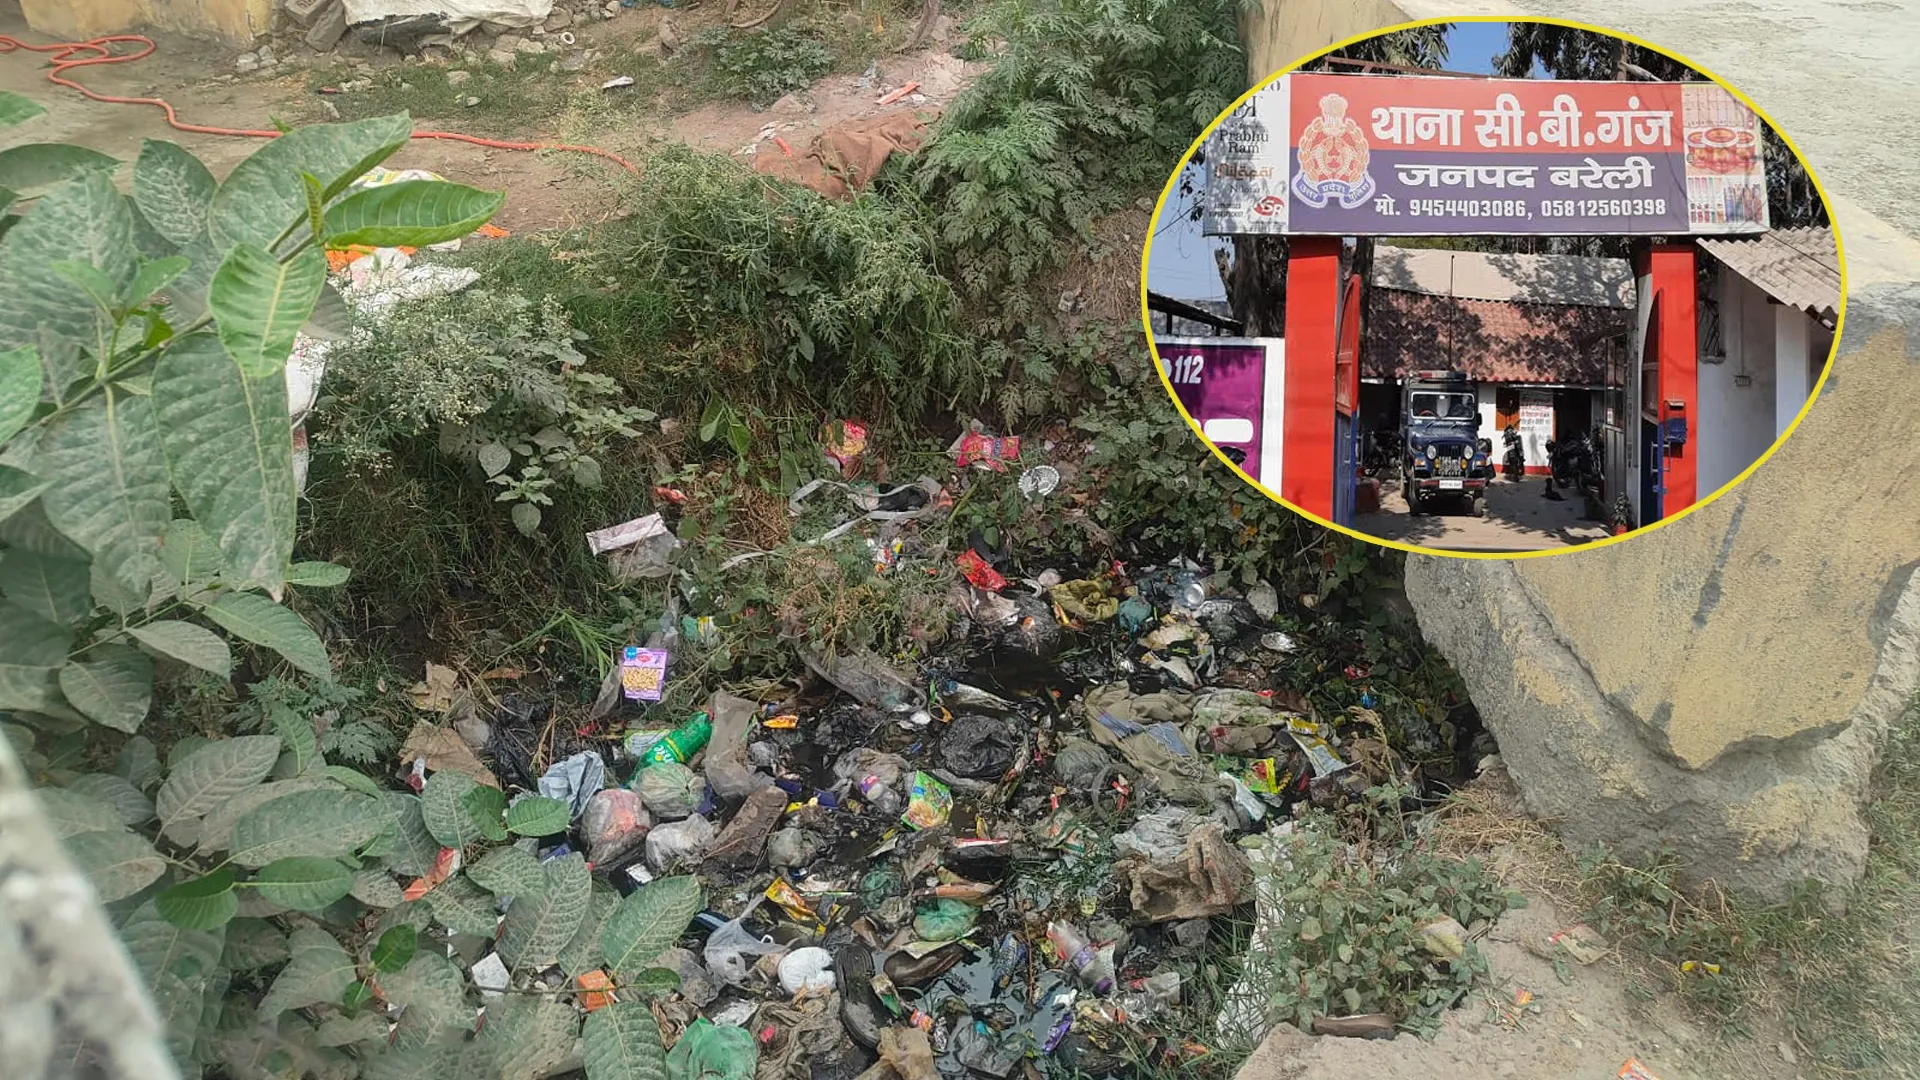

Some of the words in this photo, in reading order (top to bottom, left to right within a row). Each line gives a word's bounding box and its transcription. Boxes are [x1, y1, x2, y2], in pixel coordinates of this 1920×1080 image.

[1371, 106, 1464, 146] थाना
[1473, 93, 1674, 148] सी.बी.गंज
[1219, 130, 1268, 142] Prabhu
[1228, 142, 1260, 153] Ram
[1394, 163, 1538, 189] जनपद
[1548, 155, 1655, 189] बरेली
[1373, 194, 1401, 218] मो.
[1409, 199, 1534, 220] 9454403086,
